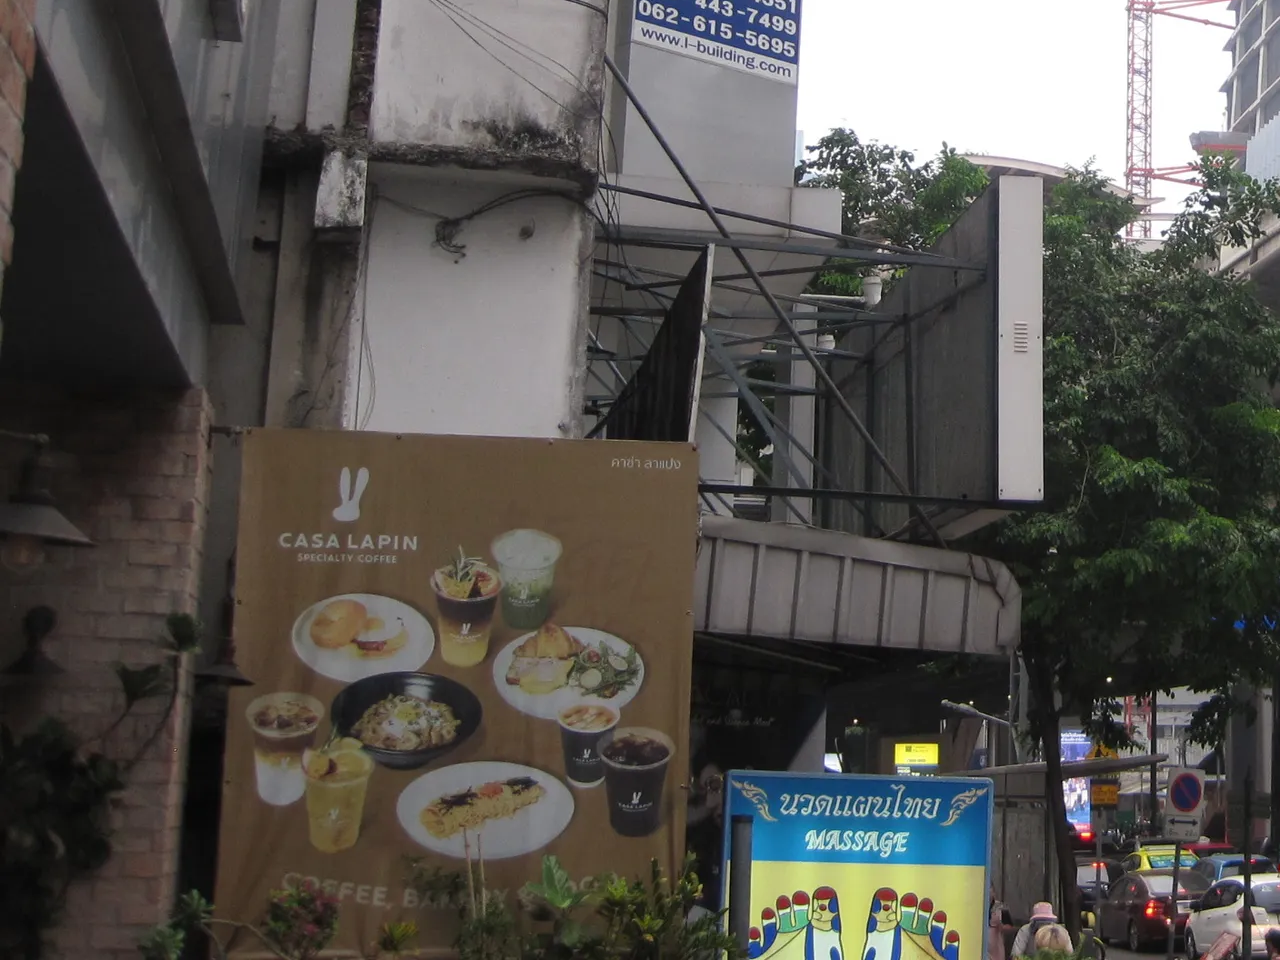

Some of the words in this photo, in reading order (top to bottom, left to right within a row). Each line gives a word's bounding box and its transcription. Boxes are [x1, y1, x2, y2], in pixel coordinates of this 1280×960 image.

[641, 27, 792, 78] www.l-building.com
[278, 532, 340, 549] CASA
[347, 534, 418, 551] LAPIN
[297, 552, 354, 563] SPECIALTY
[356, 553, 397, 564] COFFEE
[779, 783, 942, 820] นวดแผนไทย
[804, 828, 910, 858] MASSAGE
